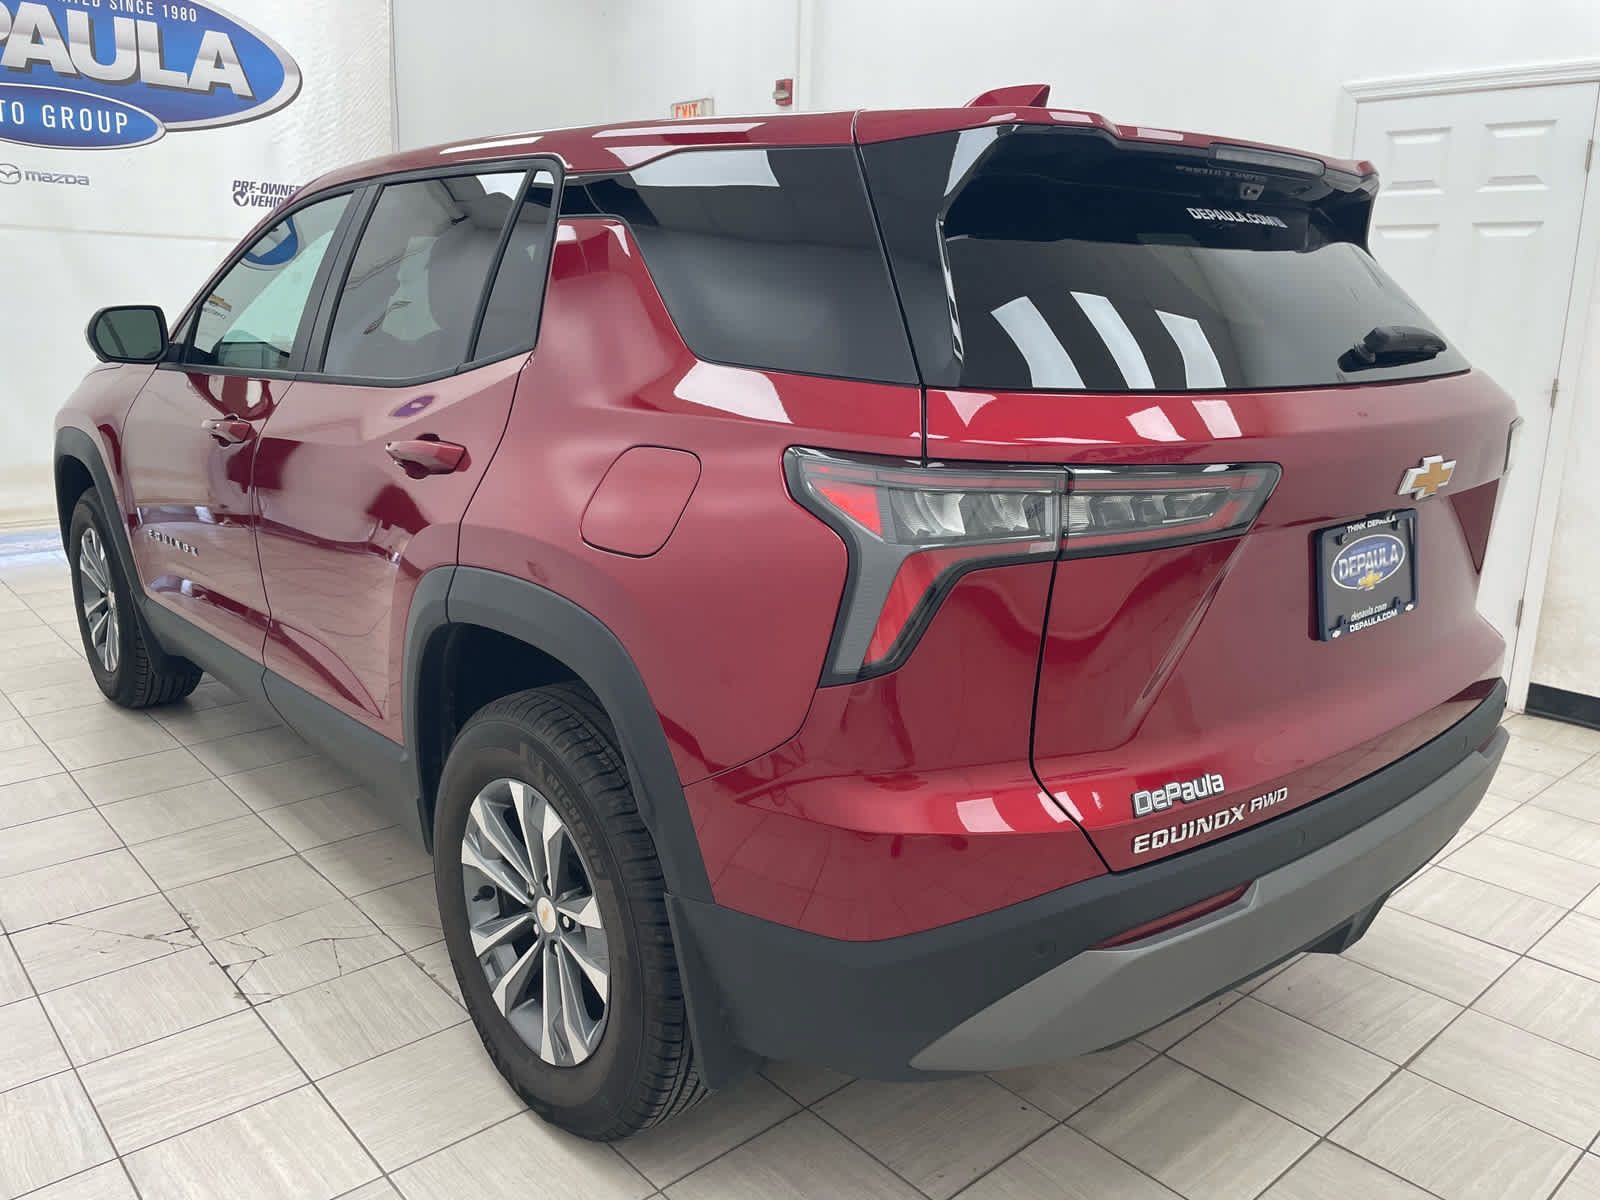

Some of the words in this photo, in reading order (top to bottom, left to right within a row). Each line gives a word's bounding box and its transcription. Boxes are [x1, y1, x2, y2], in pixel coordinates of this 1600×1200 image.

[109, 0, 154, 16] SINCE
[162, 4, 197, 23] 1980
[0, 1, 253, 97] AULA
[42, 104, 128, 134] GROUP
[232, 180, 303, 196] PRE-OWNE
[1347, 520, 1367, 533] THINK
[1367, 514, 1397, 528] DEPAULA
[1338, 543, 1400, 580] DEPAULA
[1349, 609, 1398, 632] DEPAULA.COM
[1133, 773, 1225, 817] DePaula
[1133, 804, 1246, 854] EQUINOX
[1250, 787, 1289, 813] AWD
